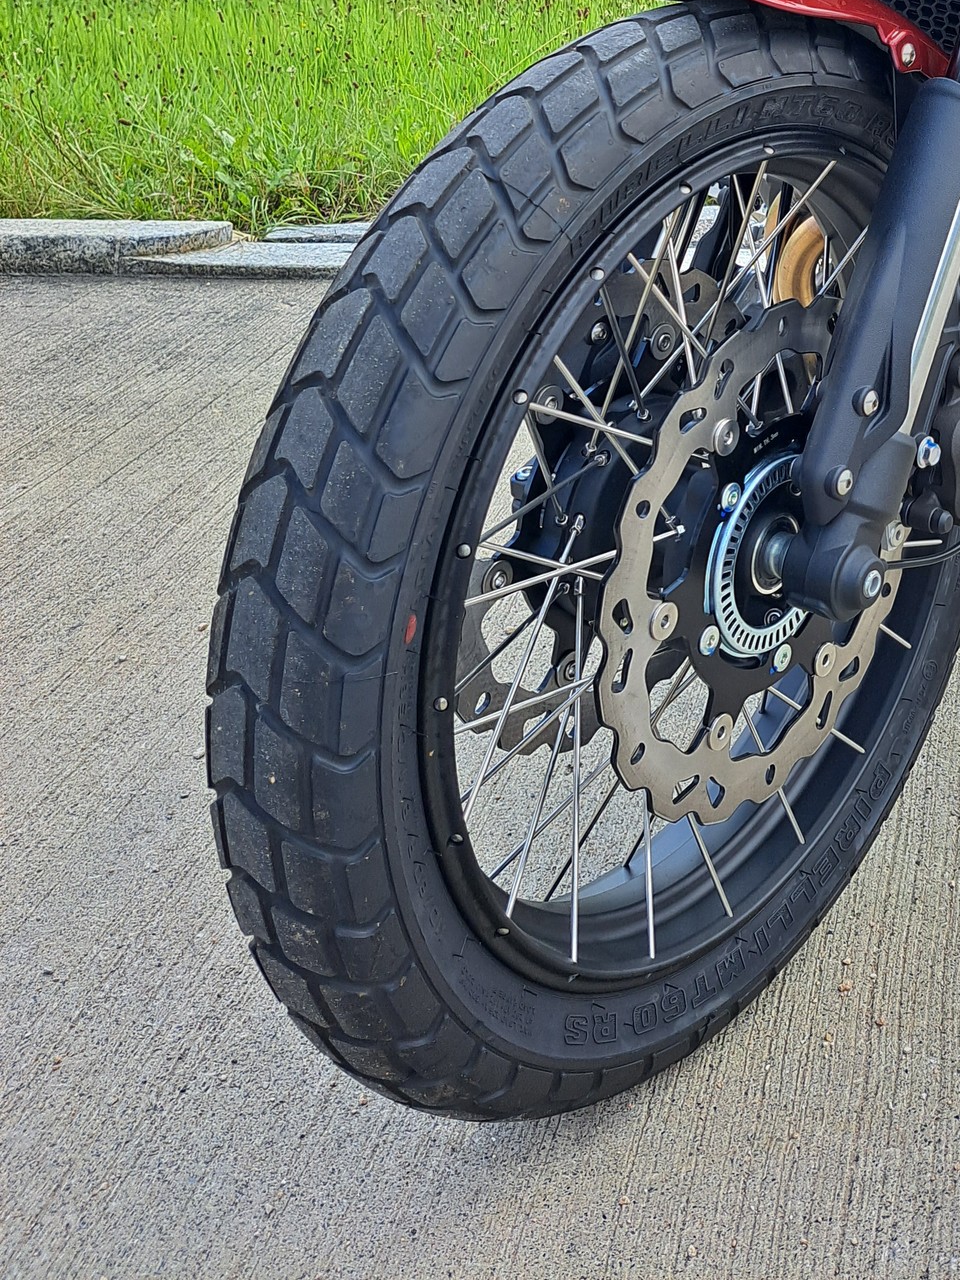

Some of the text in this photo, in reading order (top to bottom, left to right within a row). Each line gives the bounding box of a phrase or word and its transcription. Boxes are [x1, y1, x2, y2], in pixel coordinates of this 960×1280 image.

[753, 760, 892, 956] PIRELLI
[564, 1012, 617, 1045] RS
[633, 945, 746, 1035] MT60
